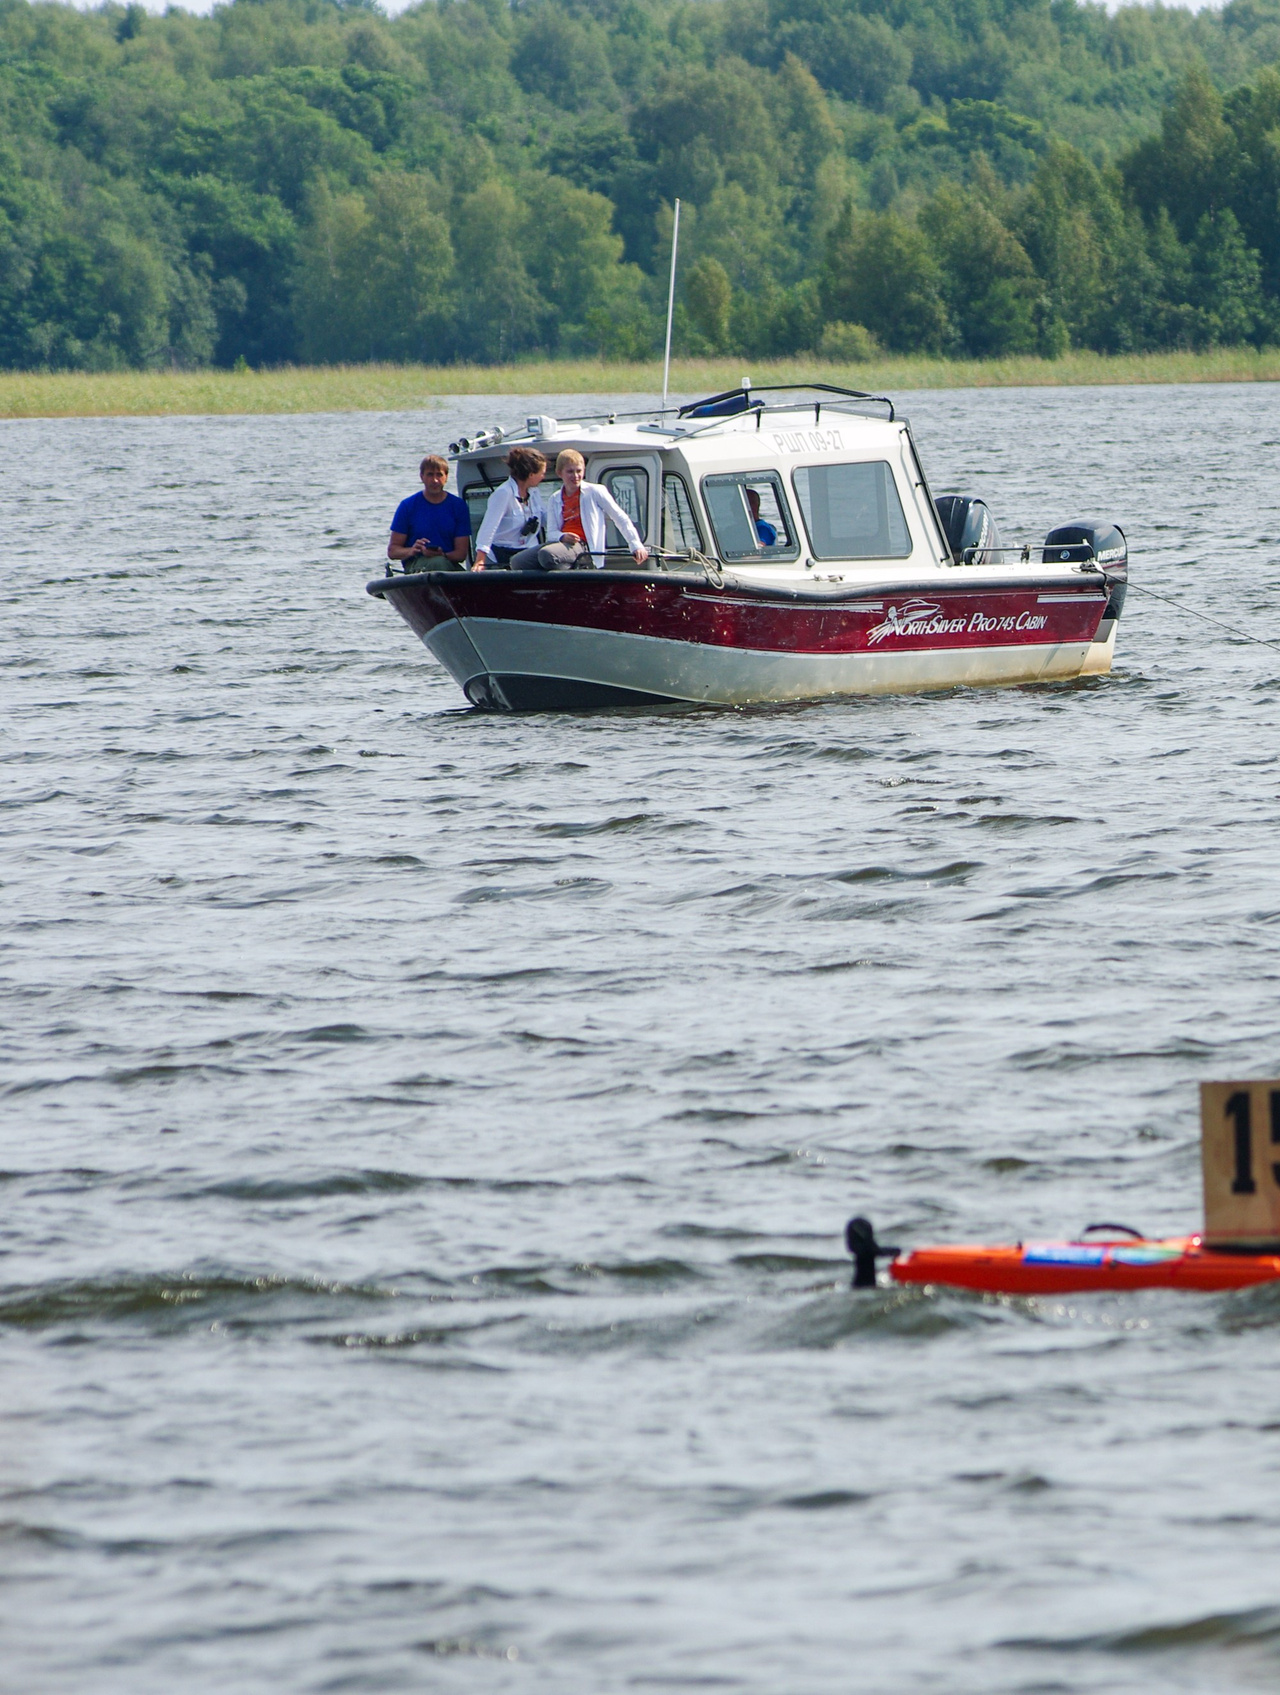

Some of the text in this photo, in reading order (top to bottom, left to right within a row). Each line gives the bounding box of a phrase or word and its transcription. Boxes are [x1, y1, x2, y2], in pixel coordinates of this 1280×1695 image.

[773, 430, 845, 454] РШП 09-27
[1097, 546, 1126, 561] MERCUR
[996, 616, 1015, 631] 745
